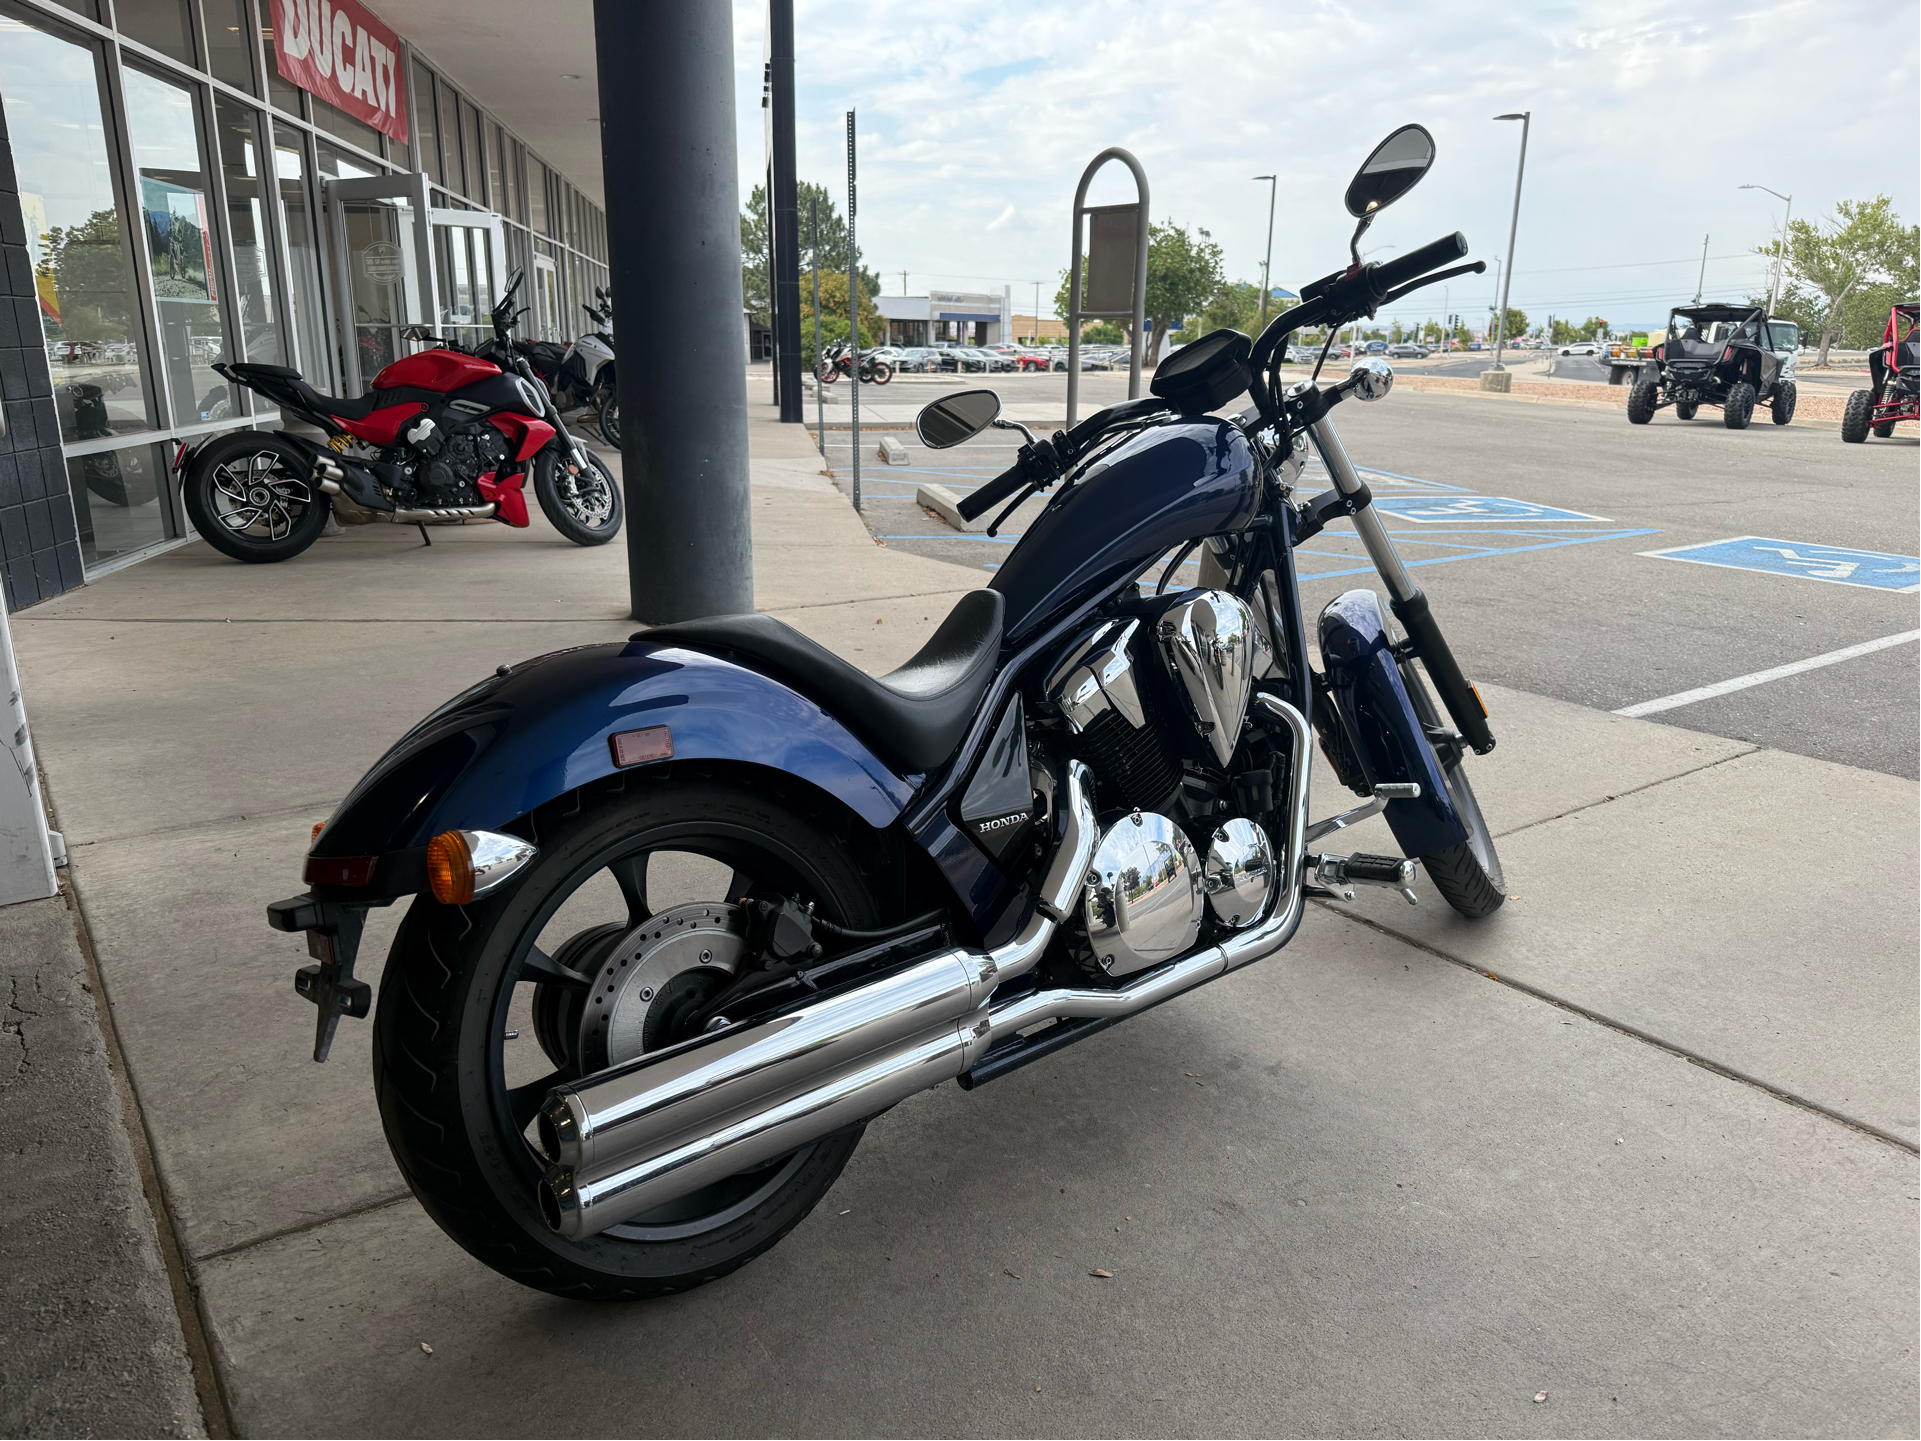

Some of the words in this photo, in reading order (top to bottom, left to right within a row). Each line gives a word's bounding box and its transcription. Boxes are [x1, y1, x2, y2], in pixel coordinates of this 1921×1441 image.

[283, 0, 396, 118] DUCATI
[1370, 343, 1385, 351] Ford
[979, 813, 1030, 833] HONDA
